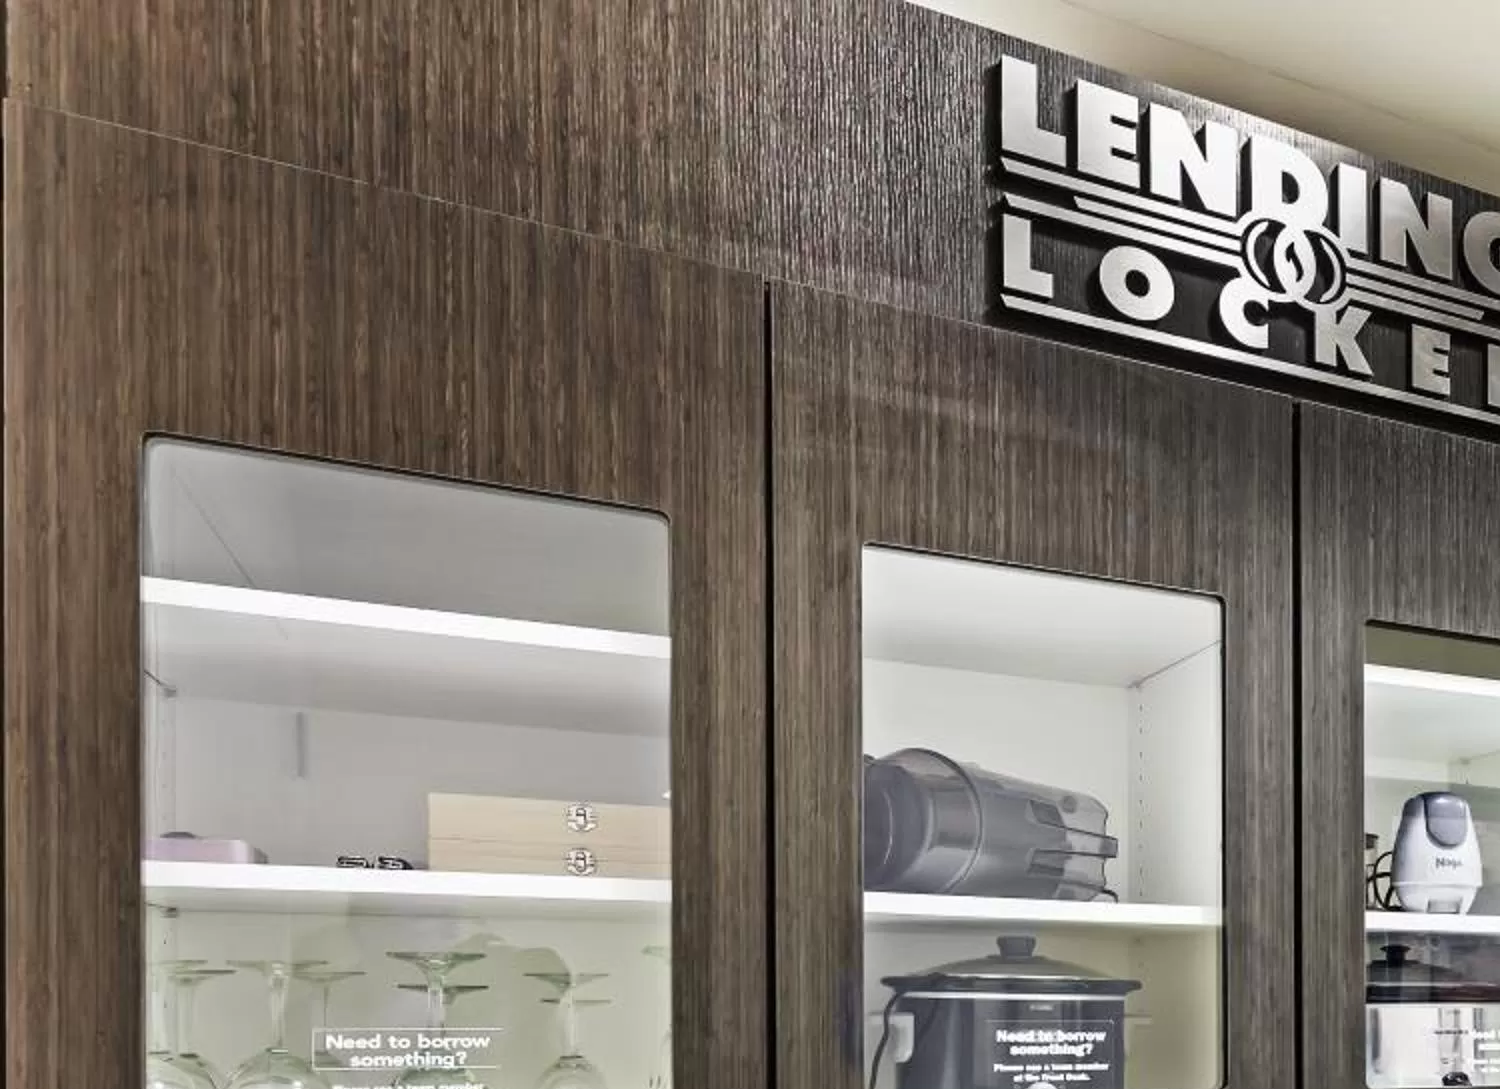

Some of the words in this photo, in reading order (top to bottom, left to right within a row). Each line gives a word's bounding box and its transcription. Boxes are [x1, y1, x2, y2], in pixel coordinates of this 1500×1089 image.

[325, 1033, 381, 1050] Need
[388, 1035, 411, 1050] to
[417, 1033, 490, 1050] borrow
[996, 1030, 1035, 1042] Need
[1057, 1029, 1107, 1042] borrow
[1009, 1043, 1094, 1057] something?
[350, 1051, 468, 1070] something?
